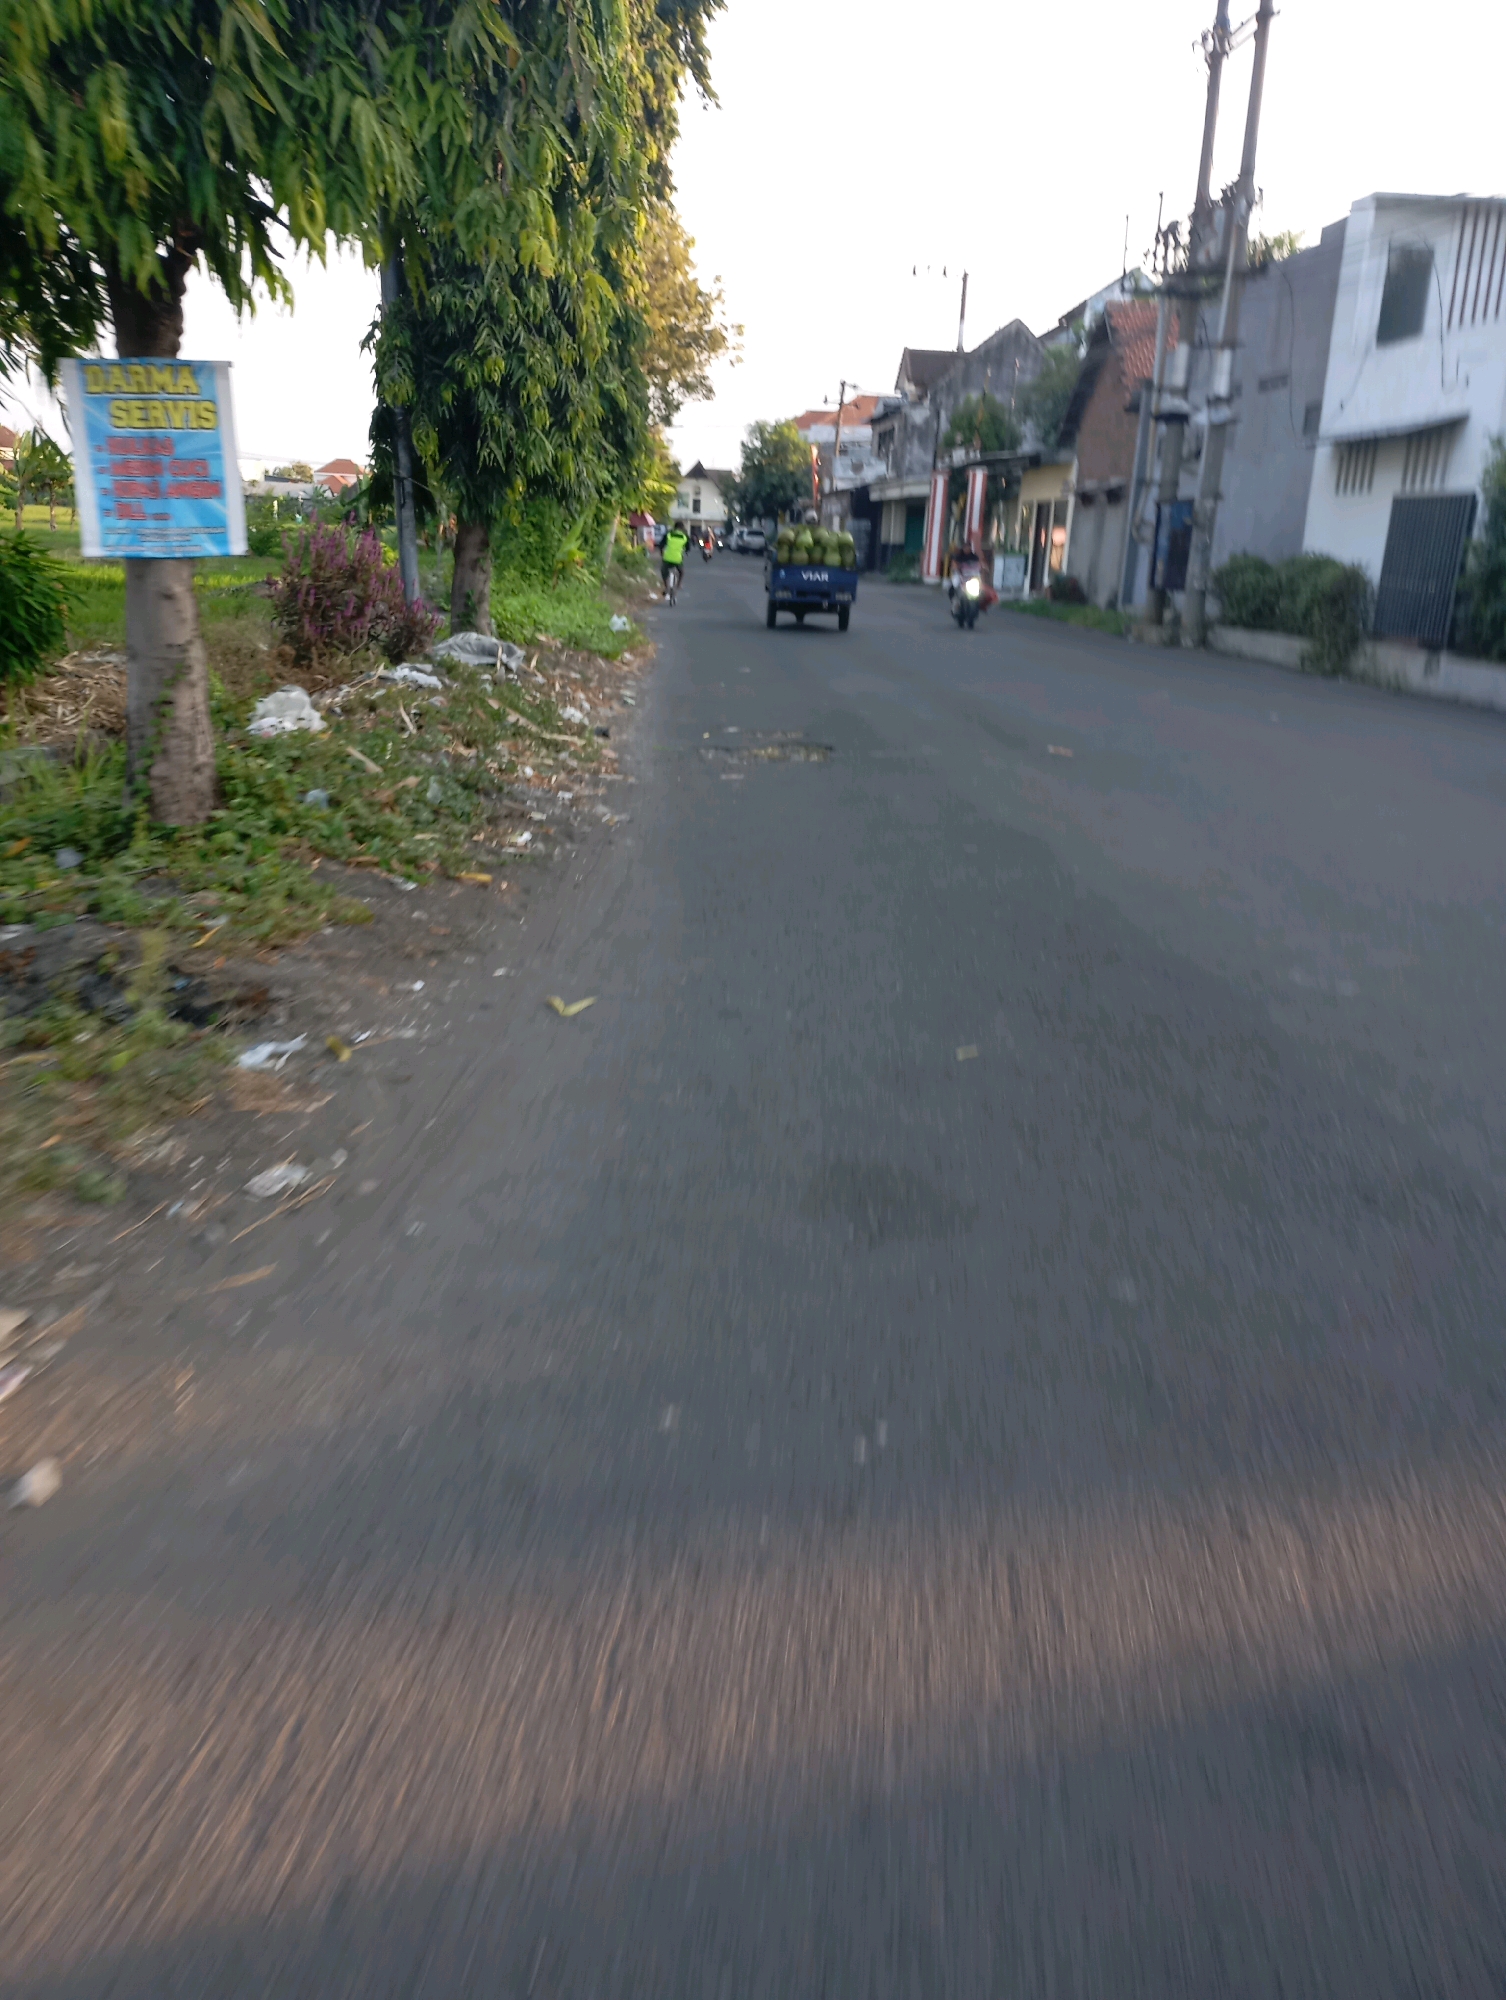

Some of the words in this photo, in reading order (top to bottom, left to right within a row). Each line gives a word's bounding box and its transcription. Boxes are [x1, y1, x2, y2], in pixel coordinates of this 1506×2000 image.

[85, 364, 199, 394] DARMA
[110, 399, 217, 429] SERVIS
[802, 570, 829, 582] VIAR
